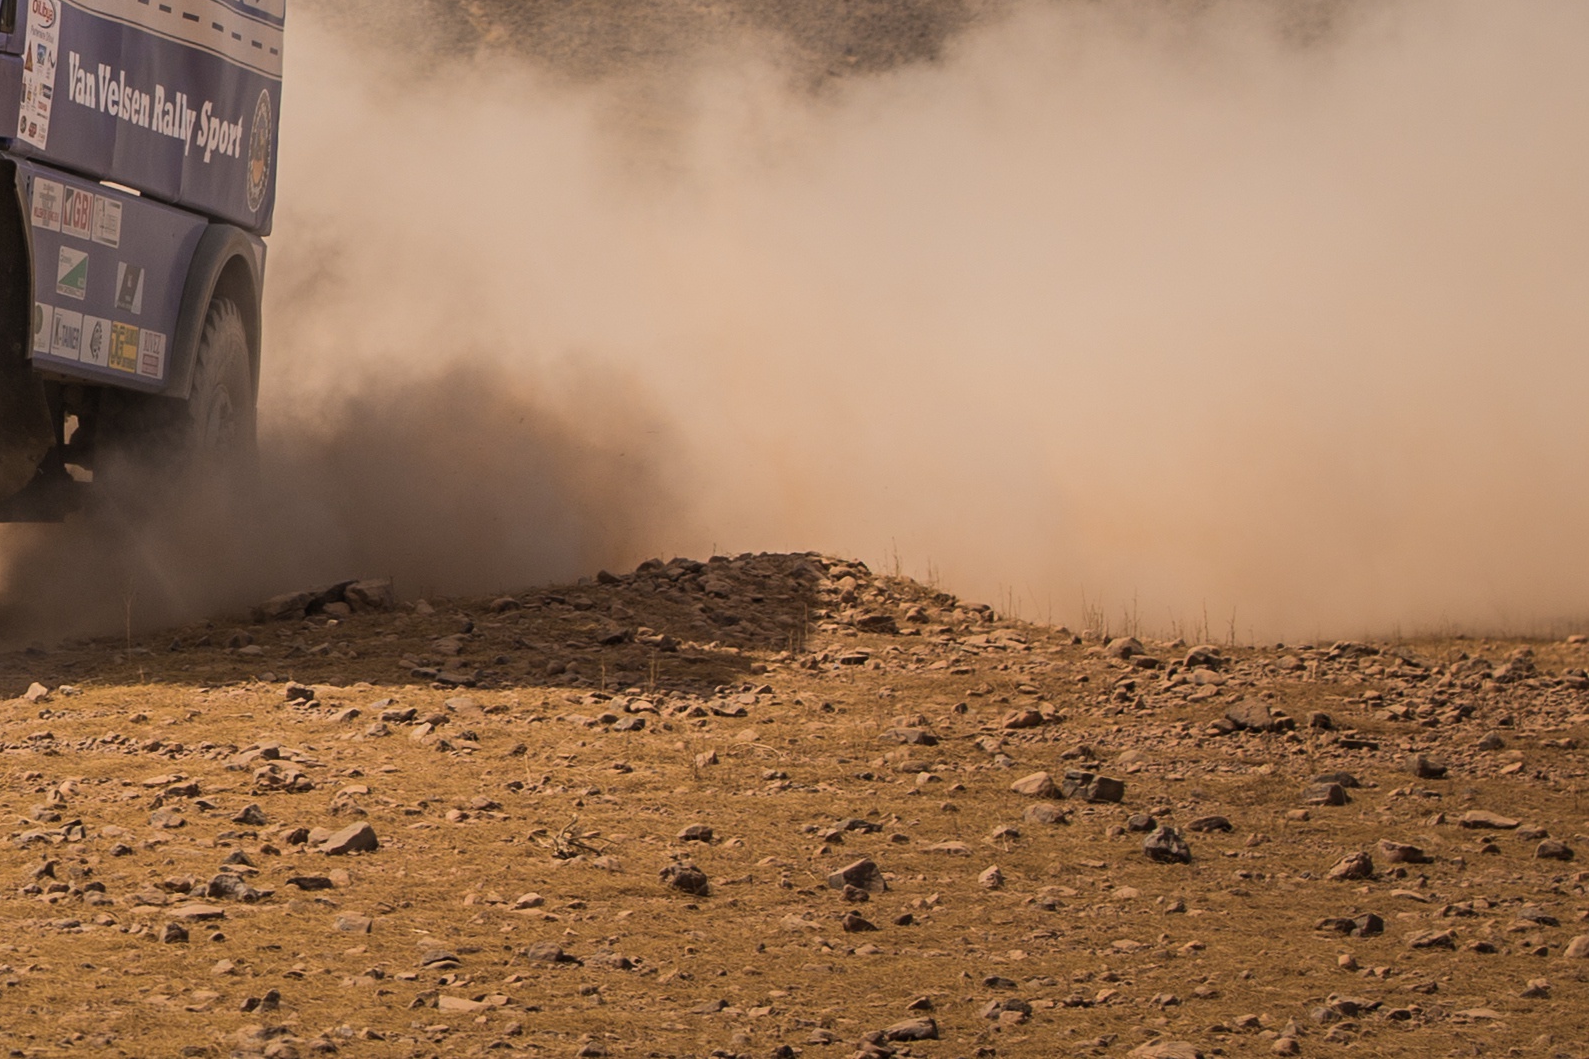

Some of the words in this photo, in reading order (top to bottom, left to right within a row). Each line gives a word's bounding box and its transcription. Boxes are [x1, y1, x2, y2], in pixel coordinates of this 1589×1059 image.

[69, 50, 96, 110] Van
[98, 62, 150, 129] Velsen
[152, 83, 197, 157] Rally
[196, 100, 244, 164] Sport
